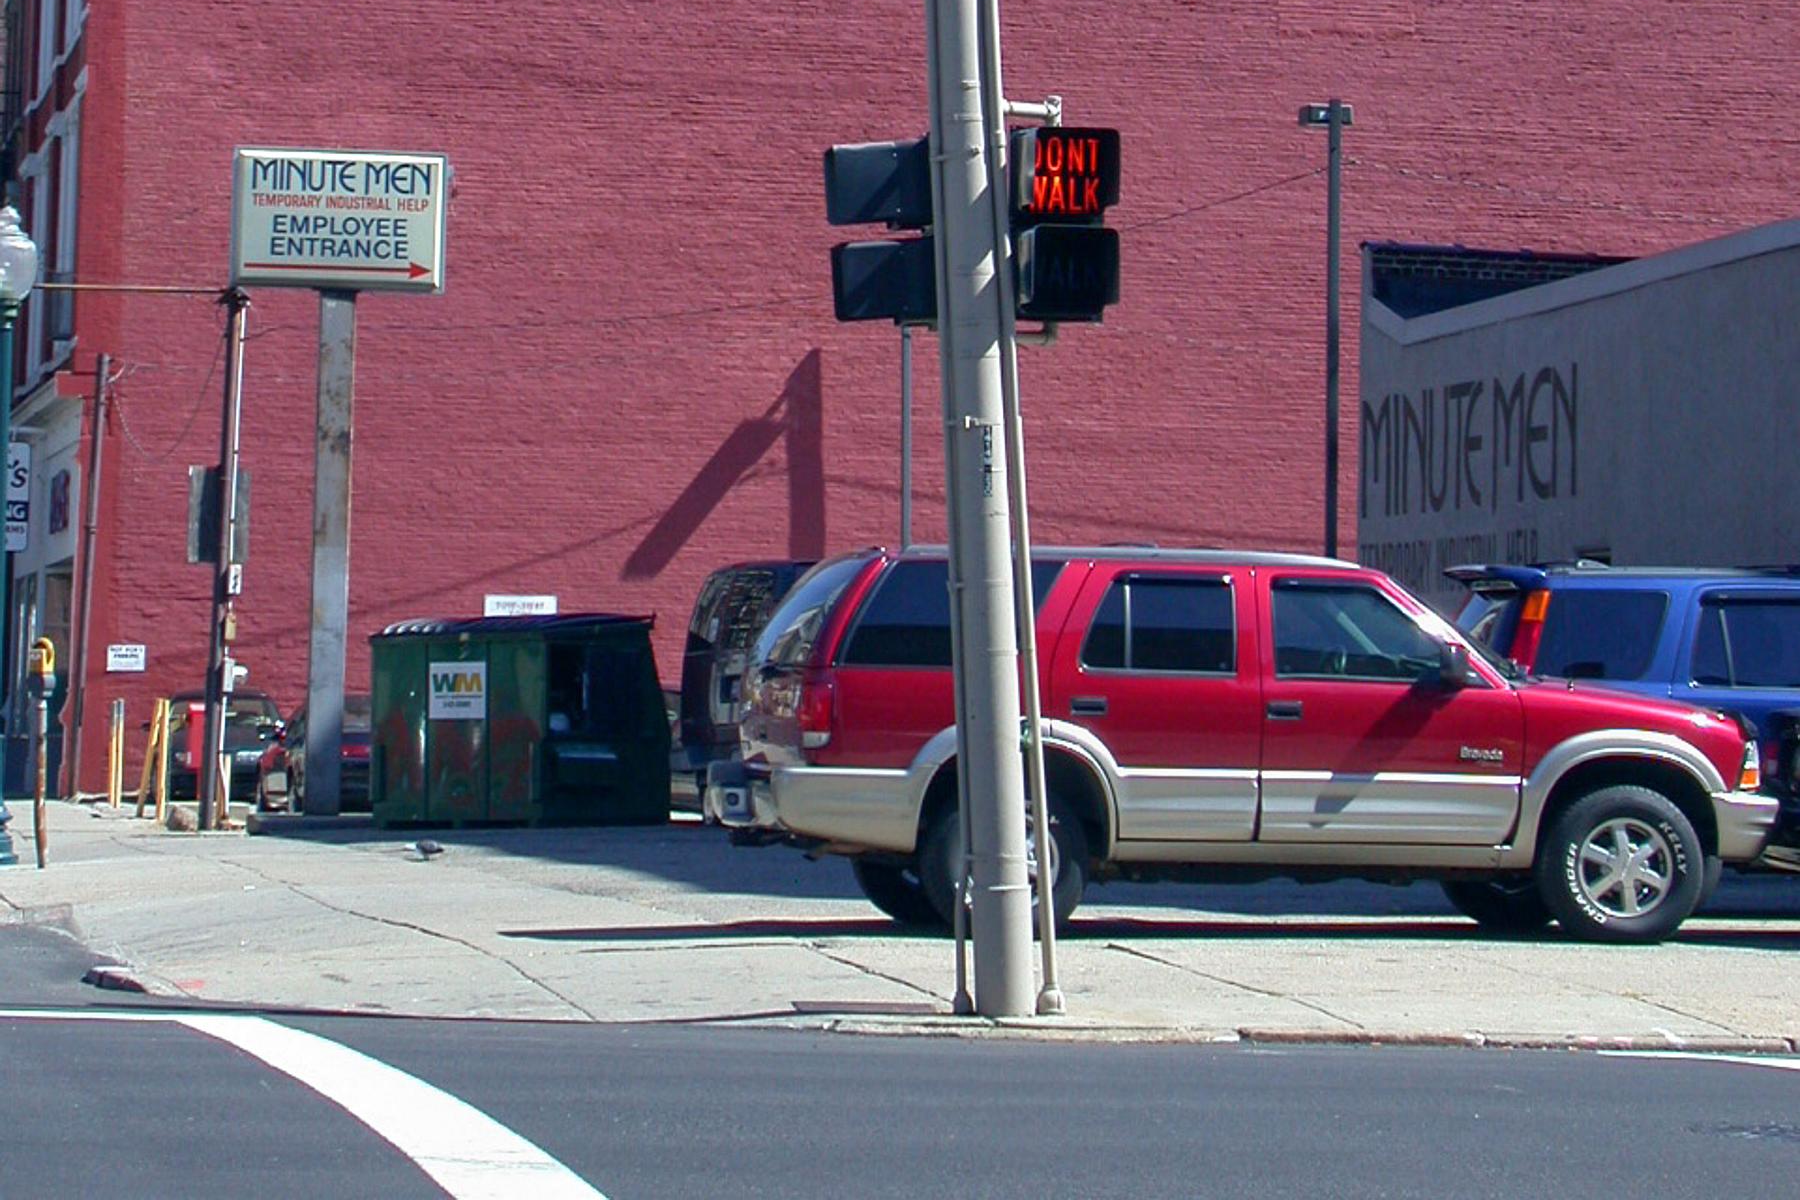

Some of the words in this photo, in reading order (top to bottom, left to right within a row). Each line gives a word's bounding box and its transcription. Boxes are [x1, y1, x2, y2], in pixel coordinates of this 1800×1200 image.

[252, 158, 356, 193] MINUTE
[365, 163, 430, 195] MEN
[252, 192, 322, 209] TEMPORARY
[325, 195, 391, 211] INDUSTRIAL
[397, 197, 429, 212] HELP
[1029, 175, 1099, 213] WALK
[272, 214, 408, 238] EMPLOYEE
[270, 236, 409, 260] ENTRANCE
[1361, 380, 1484, 519] MINUTE
[1491, 362, 1578, 516] MEN
[432, 672, 482, 693] WM
[1659, 821, 1687, 875] KELLY
